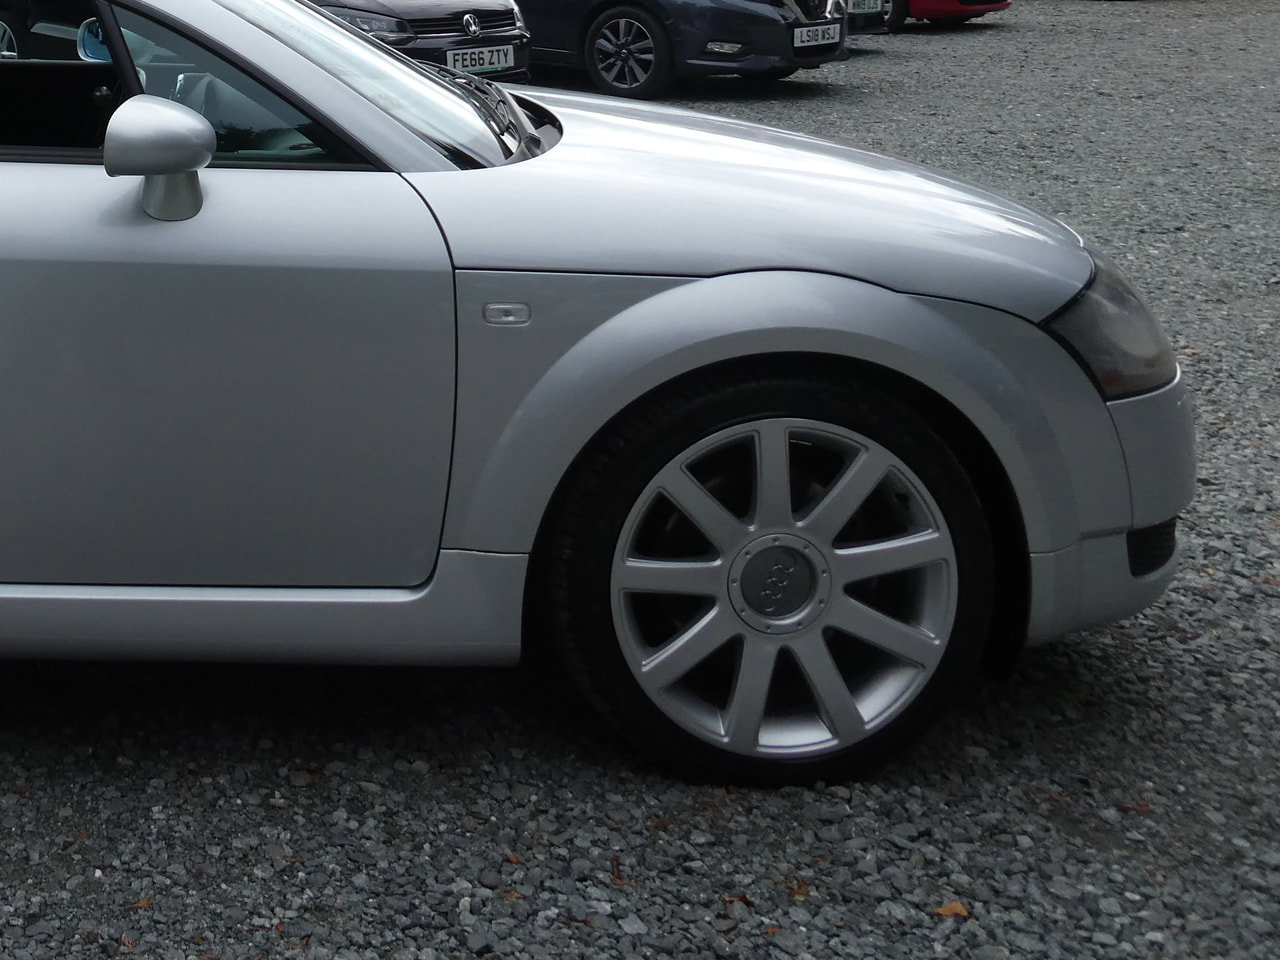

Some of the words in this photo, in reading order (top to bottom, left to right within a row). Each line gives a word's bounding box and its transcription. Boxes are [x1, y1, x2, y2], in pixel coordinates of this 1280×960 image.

[799, 28, 819, 44] LS18
[452, 50, 486, 69] FE66
[487, 48, 509, 66] ZTY
